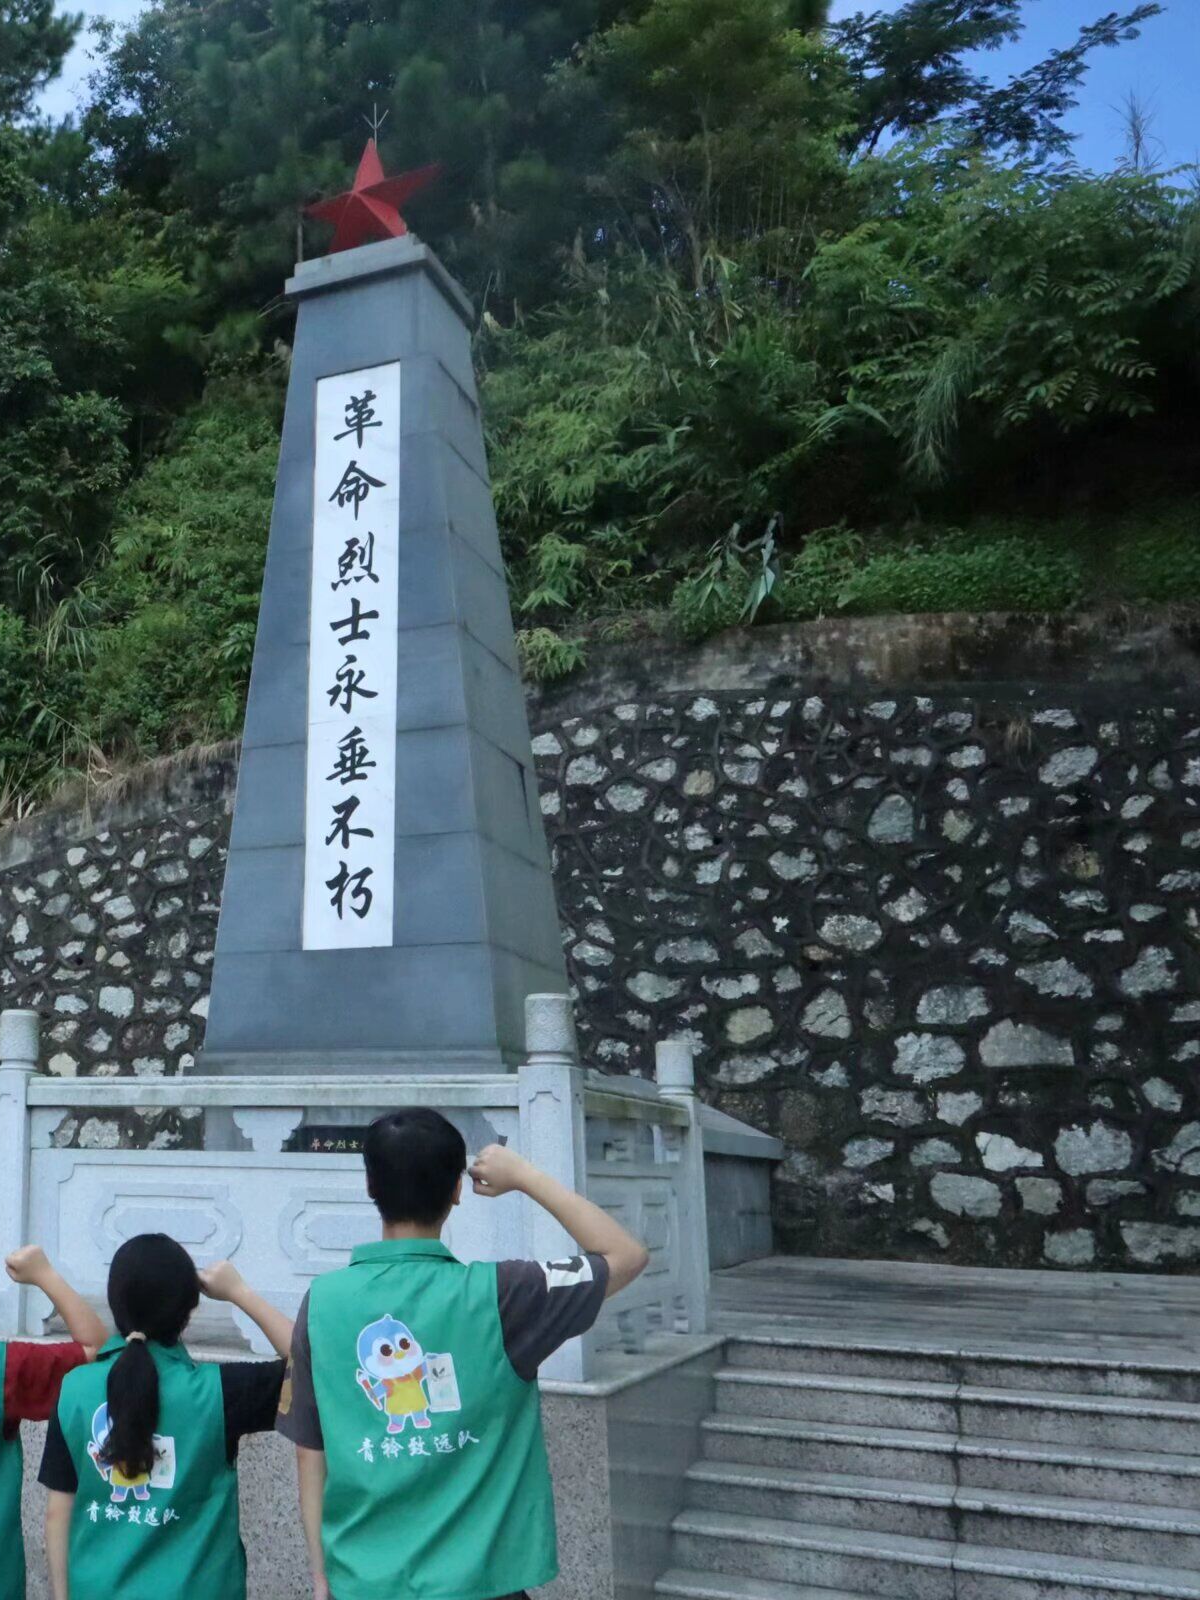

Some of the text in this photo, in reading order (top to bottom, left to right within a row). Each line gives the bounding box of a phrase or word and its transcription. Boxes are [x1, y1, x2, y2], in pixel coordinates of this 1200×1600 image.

[325, 390, 387, 921] 革命烈士永垂不朽
[311, 1138, 365, 1150] 革命烈士
